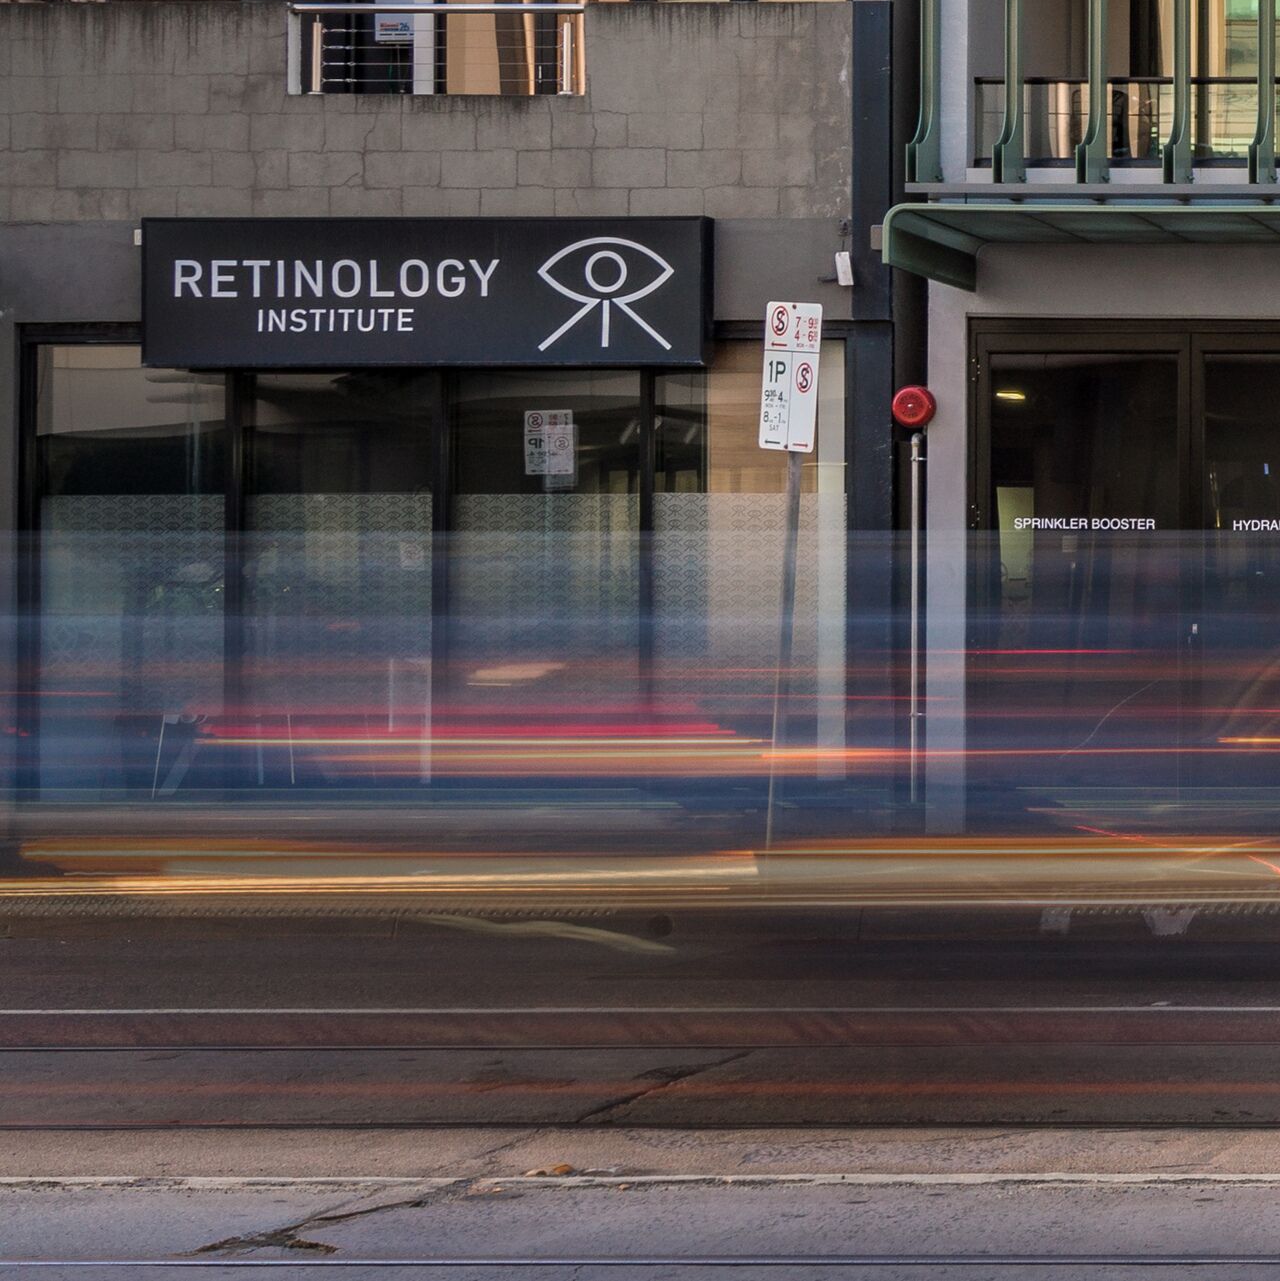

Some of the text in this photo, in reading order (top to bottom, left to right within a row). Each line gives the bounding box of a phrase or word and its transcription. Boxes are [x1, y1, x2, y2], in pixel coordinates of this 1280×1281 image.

[174, 259, 500, 298] RETINOLOGY
[257, 309, 414, 332] INSTITUTE
[768, 360, 786, 383] 1P
[1014, 518, 1156, 530] SPRINKLER BOOSTER
